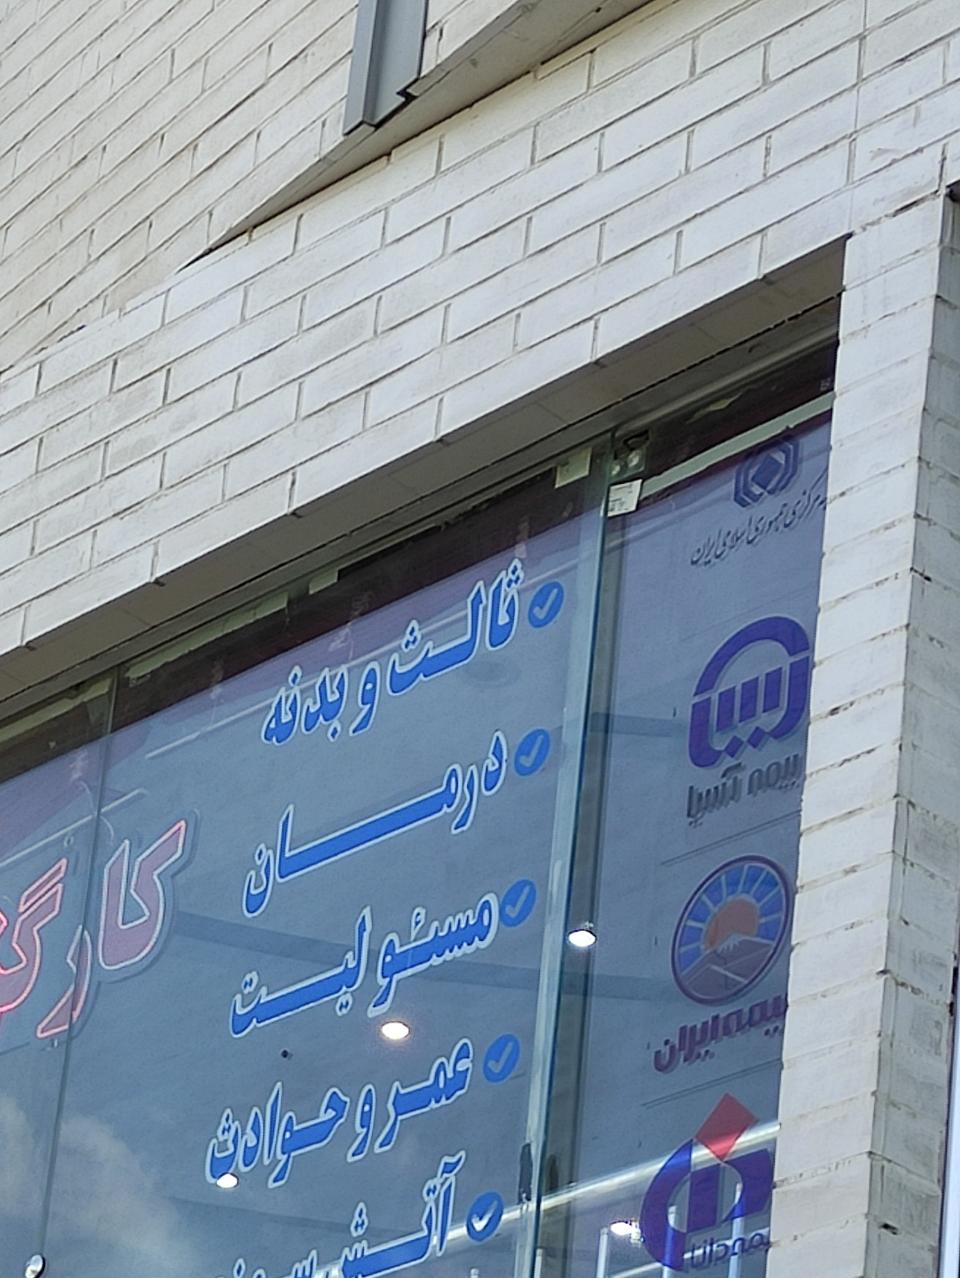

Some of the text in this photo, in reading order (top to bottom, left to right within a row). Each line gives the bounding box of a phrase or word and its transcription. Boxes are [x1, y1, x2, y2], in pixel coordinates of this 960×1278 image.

[261, 559, 525, 746] ثالث و بدنه
[243, 730, 507, 918] درمان
[686, 762, 742, 827] آسیا
[230, 892, 497, 1037] مسئولیت
[206, 1039, 473, 1188] عمر و حوادث
[654, 1013, 721, 1073] ایران
